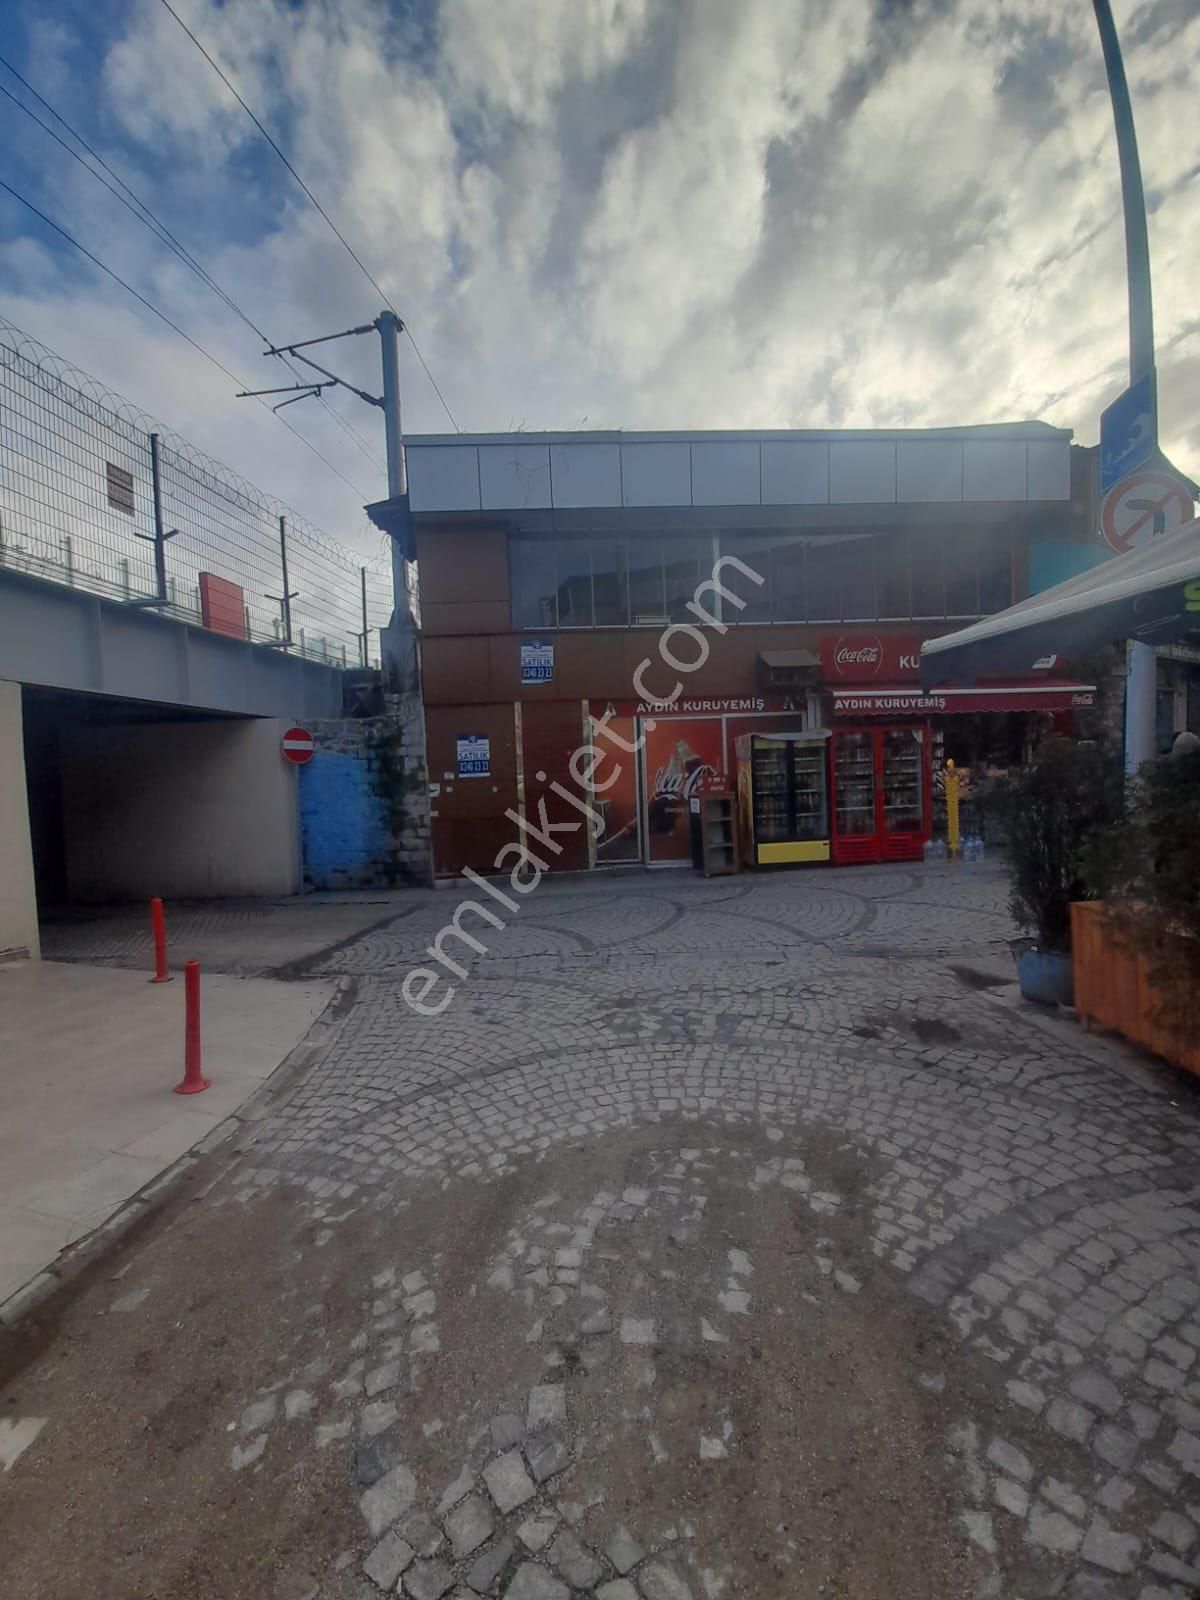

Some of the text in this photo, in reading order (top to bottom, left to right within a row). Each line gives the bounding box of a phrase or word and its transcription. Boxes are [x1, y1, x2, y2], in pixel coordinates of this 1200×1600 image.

[837, 647, 879, 663] Coca-Cola
[522, 658, 552, 666] SATILIK
[636, 697, 765, 713] AYDIN KURUYEMİŞ
[834, 696, 946, 709] AYDIN KURUYEMİŞ
[458, 752, 489, 760] SATILIK
